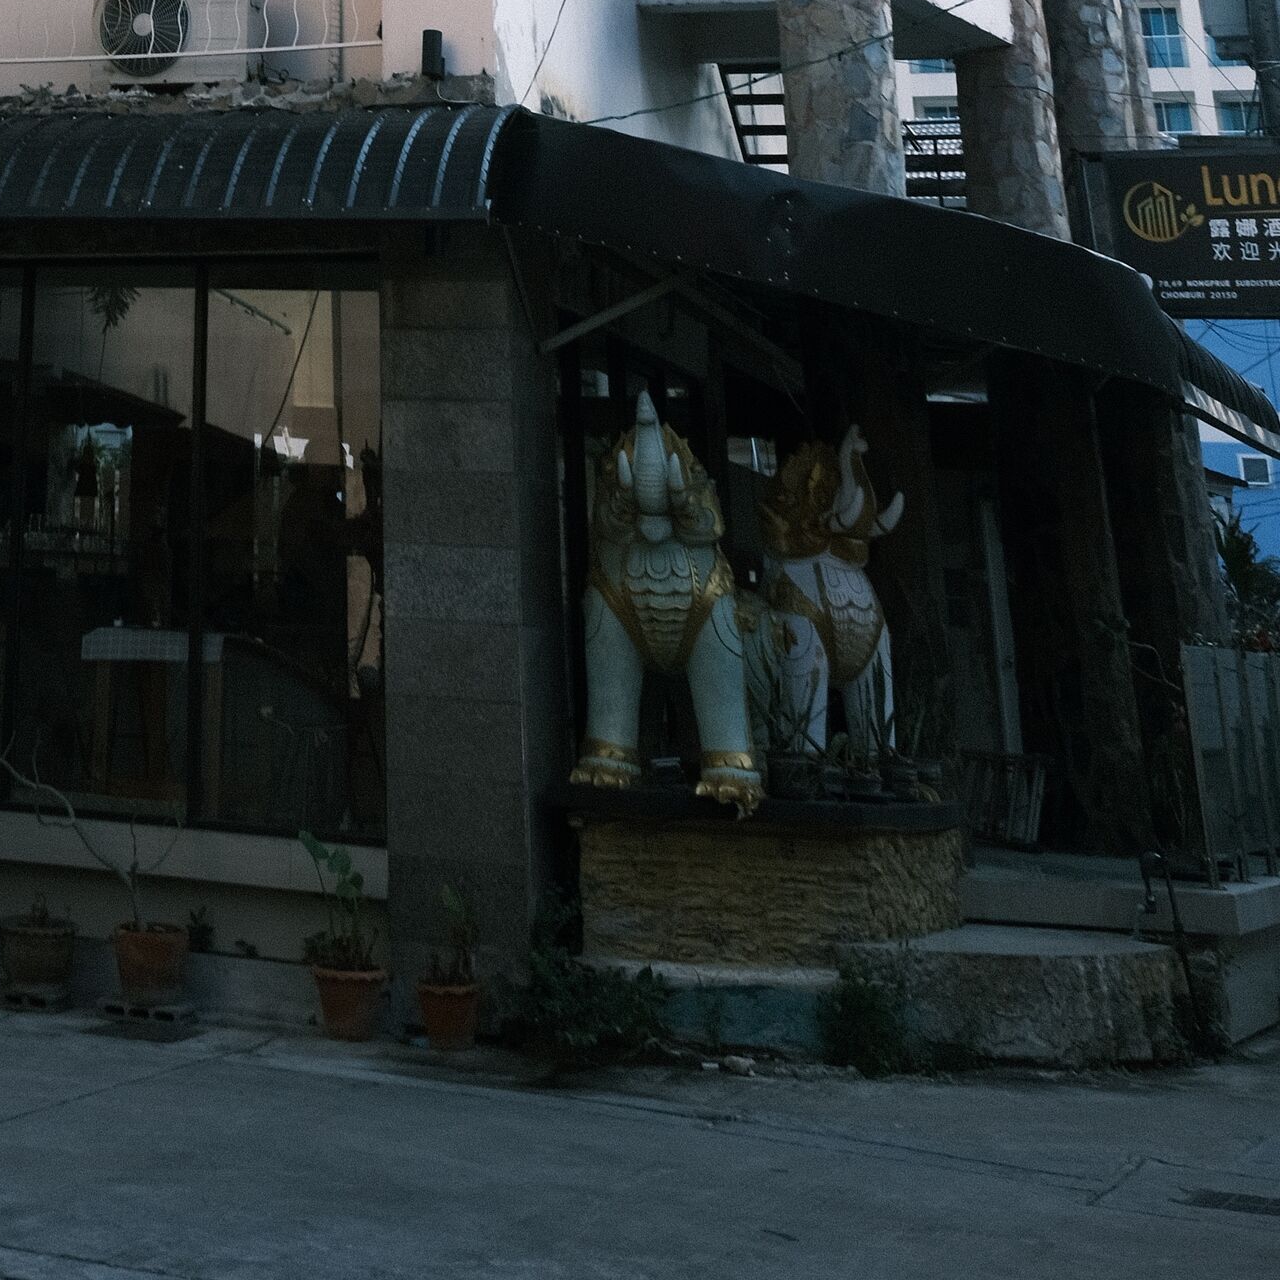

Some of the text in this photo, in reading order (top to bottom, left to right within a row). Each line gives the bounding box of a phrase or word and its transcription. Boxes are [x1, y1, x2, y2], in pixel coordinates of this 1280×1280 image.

[1201, 165, 1280, 206] Lun
[1186, 279, 1231, 288] NONGPRUE
[1161, 291, 1238, 300] CHONBURI 20150
